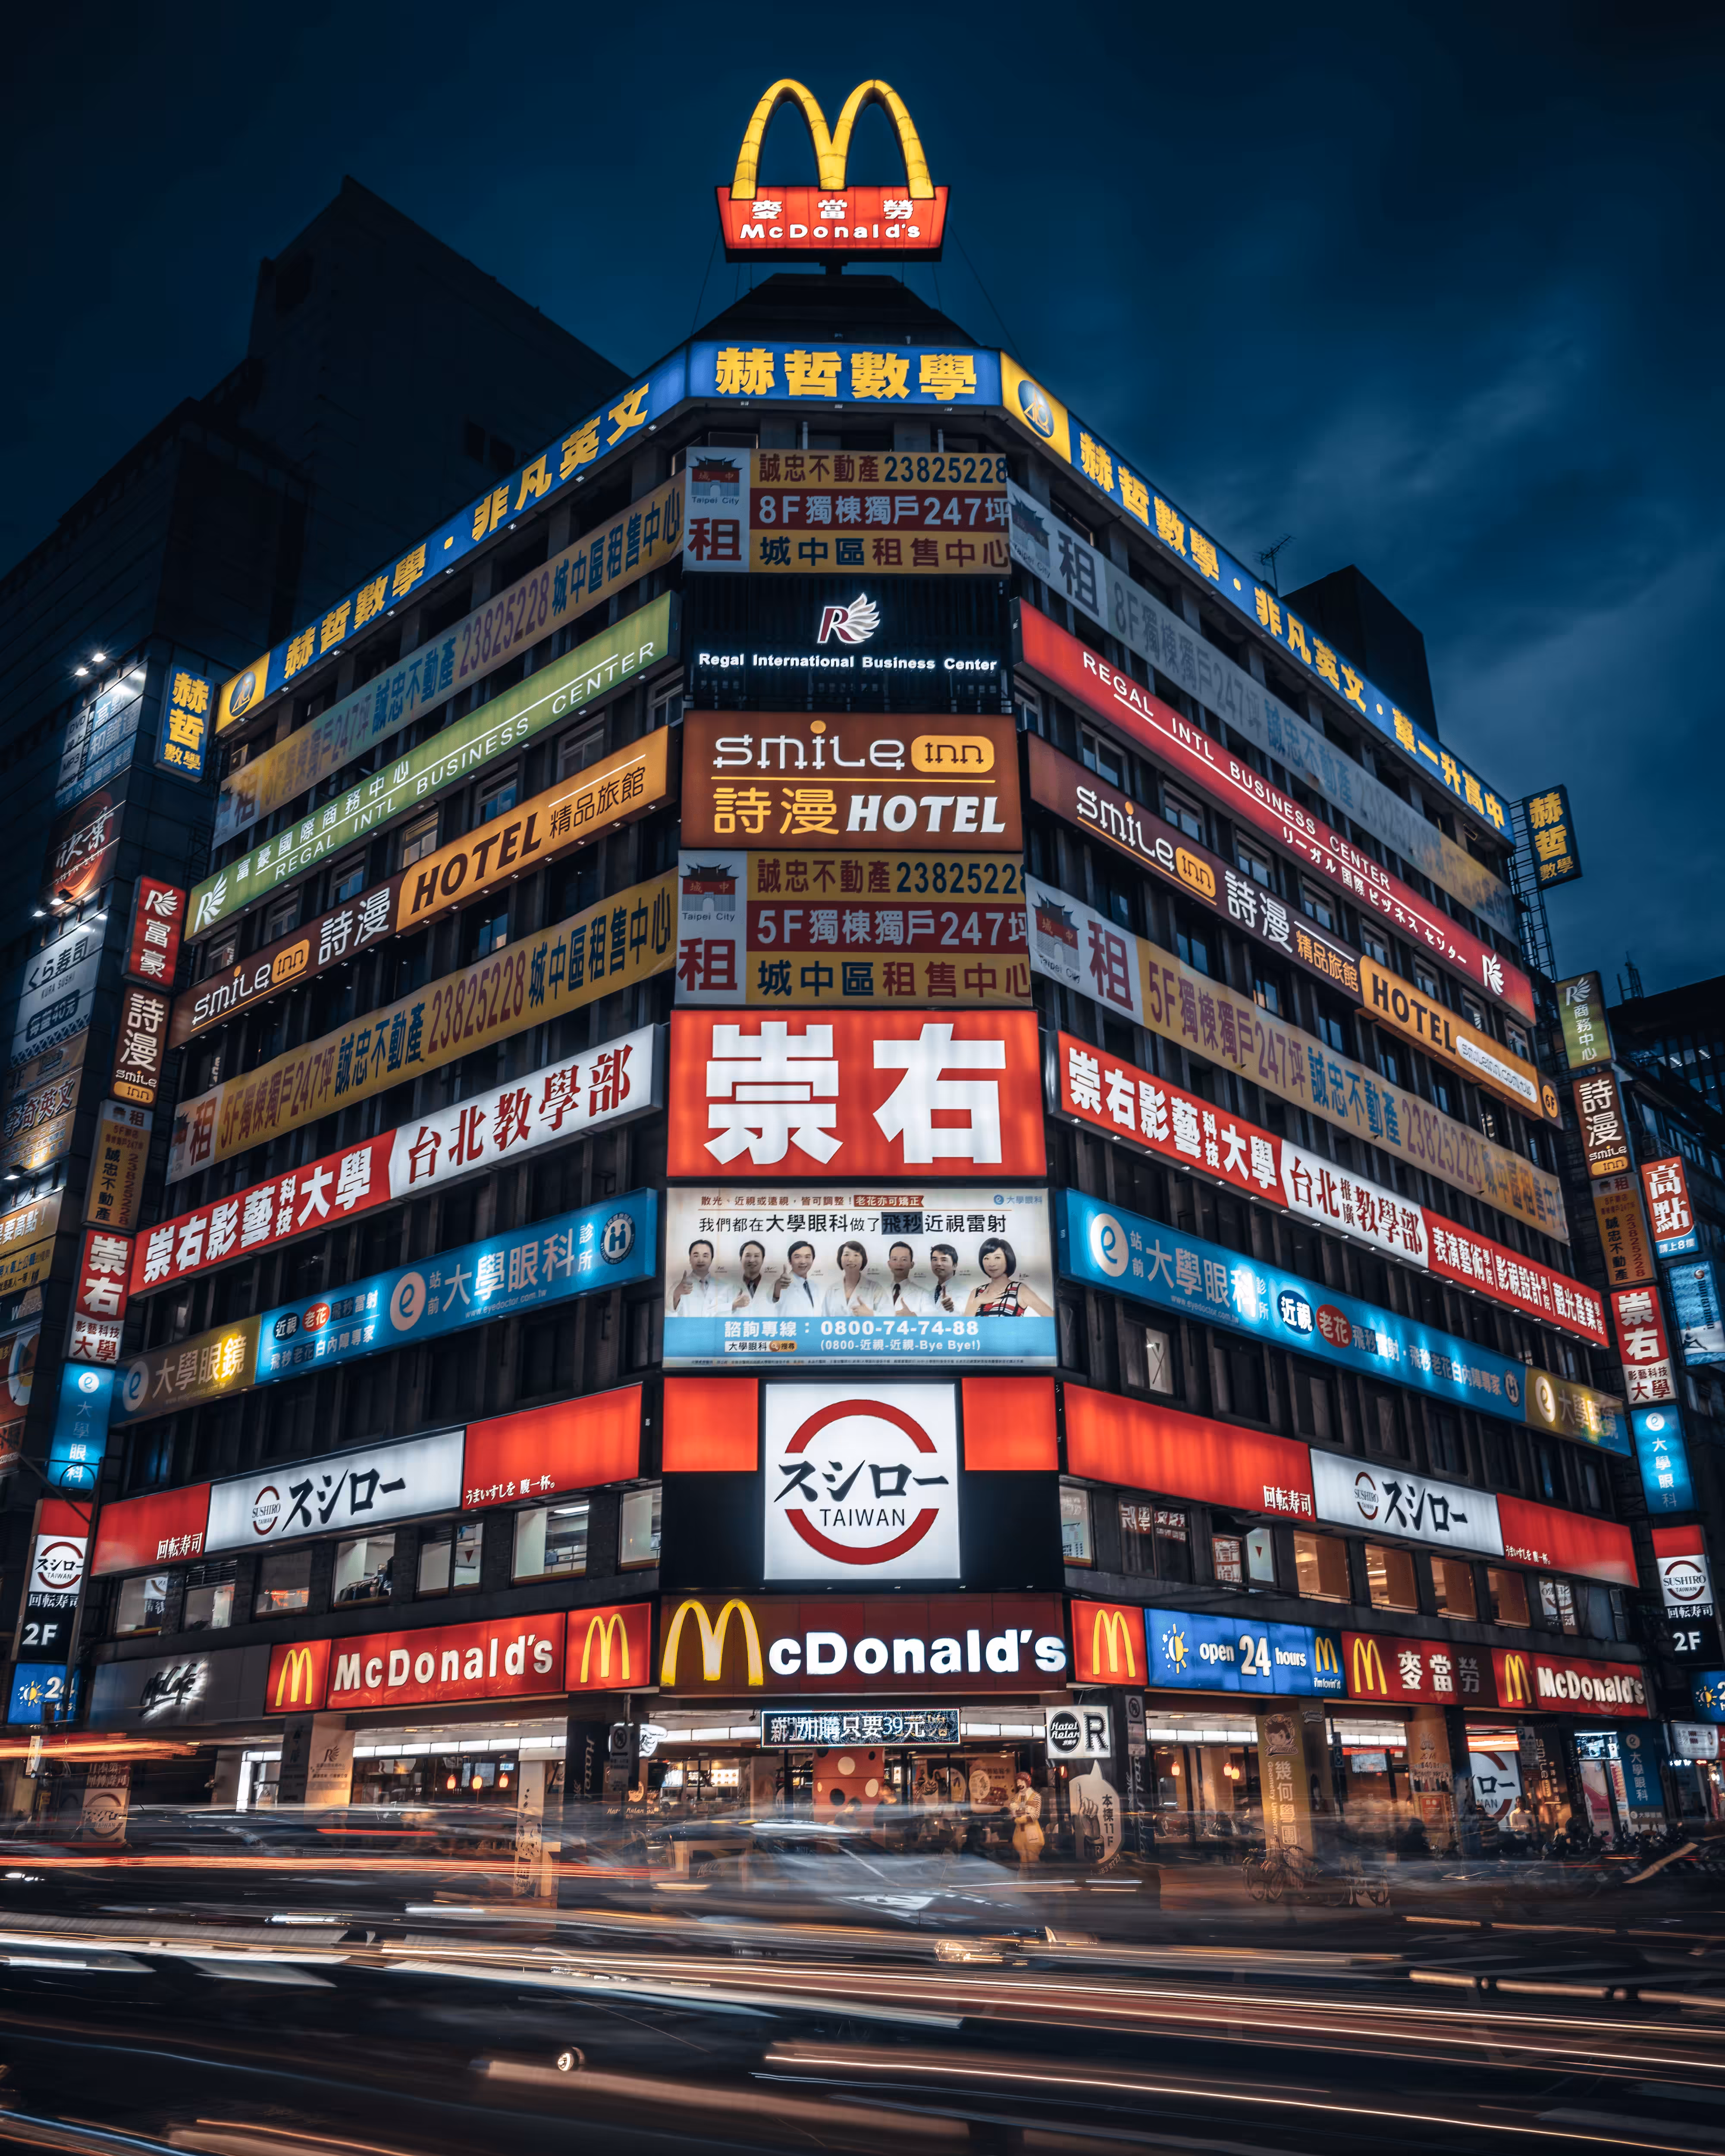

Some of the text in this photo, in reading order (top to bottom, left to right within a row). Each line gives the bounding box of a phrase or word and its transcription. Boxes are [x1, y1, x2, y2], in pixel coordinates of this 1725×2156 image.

[752, 200, 913, 219] 麥當勞
[740, 223, 920, 238] McDonald's
[715, 348, 976, 400] 赫哲數學
[760, 454, 1007, 484] 誠忠不動產 23825228
[692, 496, 739, 506] Taipei City
[759, 495, 1010, 526] 8F獨棟獨戶247坪
[552, 488, 681, 617] 城中區租售中心
[688, 518, 741, 561] 租
[760, 536, 1010, 568] 城中區租售中心
[1057, 529, 1099, 617] 租
[699, 653, 997, 671] Regal International Business Center
[275, 835, 335, 881] REGAL
[354, 799, 396, 833] INTL
[417, 718, 529, 796] BUSINESS
[552, 642, 655, 714] CENTER
[925, 742, 984, 764] inn
[1083, 651, 1154, 717] REGAL
[1172, 718, 1214, 761] INTL
[1230, 761, 1316, 835] BUSINESS
[1330, 836, 1390, 890] CENTER
[237, 761, 409, 883] 富豪國際商務中心
[713, 787, 1006, 835] 詩漫 HOTEL
[317, 767, 645, 965] 詩漫 HOTEL 精品旅館
[757, 859, 891, 894] 誠忠不動產
[1182, 857, 1211, 889] inn
[682, 912, 735, 922] Taipei City
[140, 918, 171, 978] 富豪
[276, 949, 304, 976] inn
[678, 937, 737, 991] 租
[1225, 870, 1456, 1054] 詩漫 精品旅館 HOTEL
[335, 1003, 425, 1097] 誠忠不動產
[428, 950, 526, 1054] 23825228
[529, 887, 671, 1008] 城中區租售中心
[757, 961, 1031, 998] 城中區租售中心
[120, 993, 164, 1072] 詩漫
[1574, 1003, 1597, 1061] 商務中心
[1088, 920, 1133, 1011] 租
[1402, 1099, 1482, 1190] 23825228
[127, 1086, 149, 1101] inn
[703, 1021, 1007, 1166] 崇右
[1069, 1047, 1276, 1189] 崇右影藝科技大學
[1579, 1079, 1622, 1147] 詩漫
[189, 1098, 216, 1166] 租
[144, 1044, 633, 1283] 崇右影藝科技大學 台北教學部
[1603, 1160, 1625, 1172] inn
[856, 1196, 920, 1206] 老花亦可矯正
[1007, 1196, 1042, 1204] 大學眼科
[1646, 1163, 1690, 1233] 高點
[83, 1235, 128, 1316] 崇右
[75, 1321, 120, 1338] 影藝科技
[276, 1316, 298, 1338] 近視
[304, 1304, 328, 1327] 老花
[821, 1320, 979, 1335] 0800-74-74-88
[1281, 1296, 1349, 1344] 近視 老花
[1618, 1291, 1659, 1361] 崇右
[72, 1339, 118, 1362] 大學
[728, 1342, 767, 1351] 大學眼科
[948, 1339, 980, 1352] Bye!)
[1628, 1366, 1668, 1381] 影藝科技
[1631, 1379, 1671, 1401] 大學
[774, 1460, 949, 1502] スシロー
[1652, 1438, 1677, 1508] 大學眼科
[252, 1503, 281, 1518] SUSHIRO
[282, 1467, 405, 1532] スシロー
[466, 1482, 516, 1505] うまいすしを
[1263, 1485, 1312, 1516] 回転寿司
[1354, 1489, 1379, 1504] SUSHIRO
[1361, 1502, 1374, 1510] TAIWAN
[1382, 1480, 1468, 1532] スシロー
[820, 1509, 905, 1527] TAIWAN
[157, 1532, 203, 1560] 回転寿司
[35, 1558, 84, 1571] スシロー
[1663, 1575, 1706, 1586] SUSHIRO
[1667, 1604, 1713, 1619] 回転寿司
[22, 1623, 59, 1645] 2F
[1673, 1631, 1701, 1651] 2F
[333, 1634, 553, 1691] McDonald's
[1199, 1635, 1306, 1676] open 24 hours
[1398, 1650, 1479, 1693] 麥當勞
[1537, 1666, 1644, 1705] McDonald's
[1051, 1722, 1078, 1730] Hotel
[1083, 1712, 1109, 1752] R
[1267, 1761, 1276, 1800] Geometry
